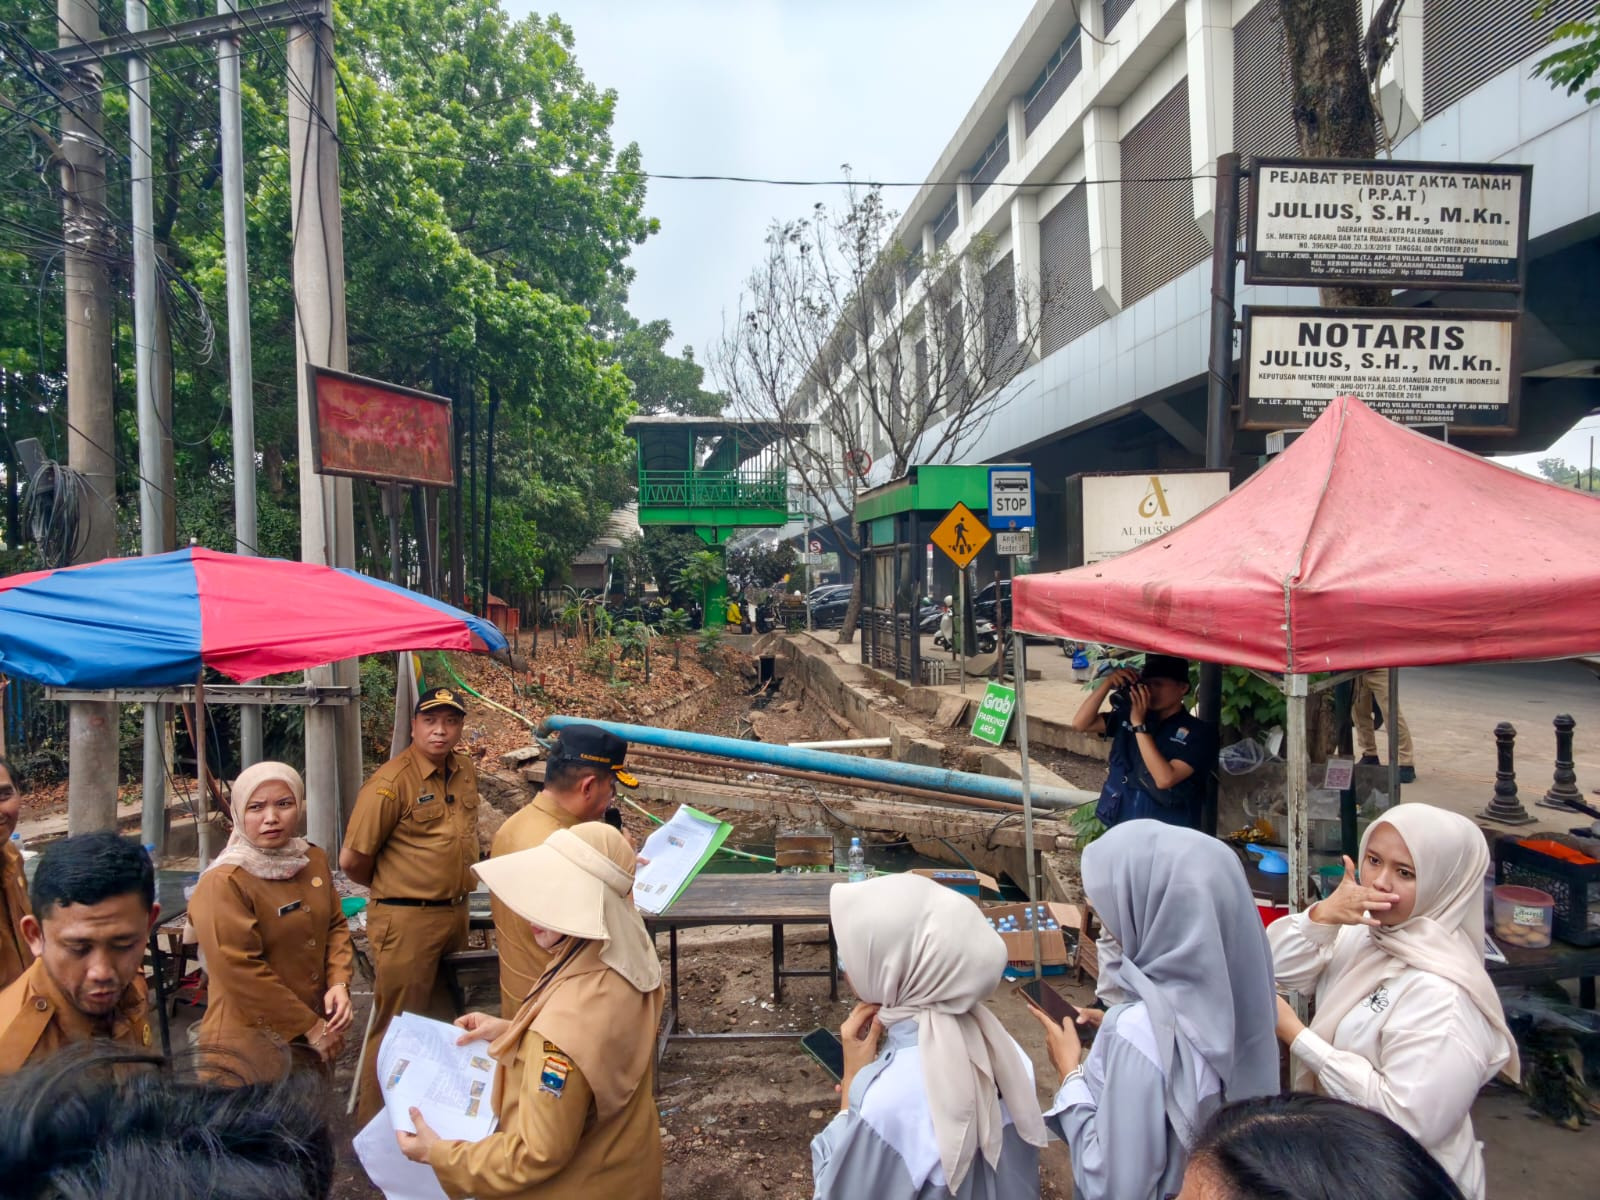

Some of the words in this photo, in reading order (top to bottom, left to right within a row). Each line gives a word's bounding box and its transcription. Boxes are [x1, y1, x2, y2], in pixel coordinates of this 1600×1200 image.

[1270, 170, 1338, 184] PEJABAT
[1343, 173, 1414, 186] PEMBUAT
[1418, 175, 1458, 189] AKTA
[1462, 177, 1511, 190] TANAH
[1267, 202, 1362, 223] JULIUS,
[1372, 204, 1430, 225] S.H.,
[1440, 207, 1511, 225] M.Kn.
[1363, 226, 1383, 234] KERJA
[1265, 232, 1277, 240] SK.
[1309, 233, 1337, 241] AGRARIA
[1417, 236, 1438, 244] BADAN
[1439, 237, 1479, 245] PERTANAHAN
[1298, 322, 1465, 350] NOTARIS
[1260, 350, 1350, 371] JULIUS,
[1361, 353, 1418, 373] S.H.,
[1429, 355, 1501, 371] M.Kn.
[996, 497, 1027, 511] STOP
[1121, 527, 1136, 536] AL
[984, 693, 1010, 714] Grab
[978, 712, 1006, 727] PARKING
[980, 724, 996, 735] AREA
